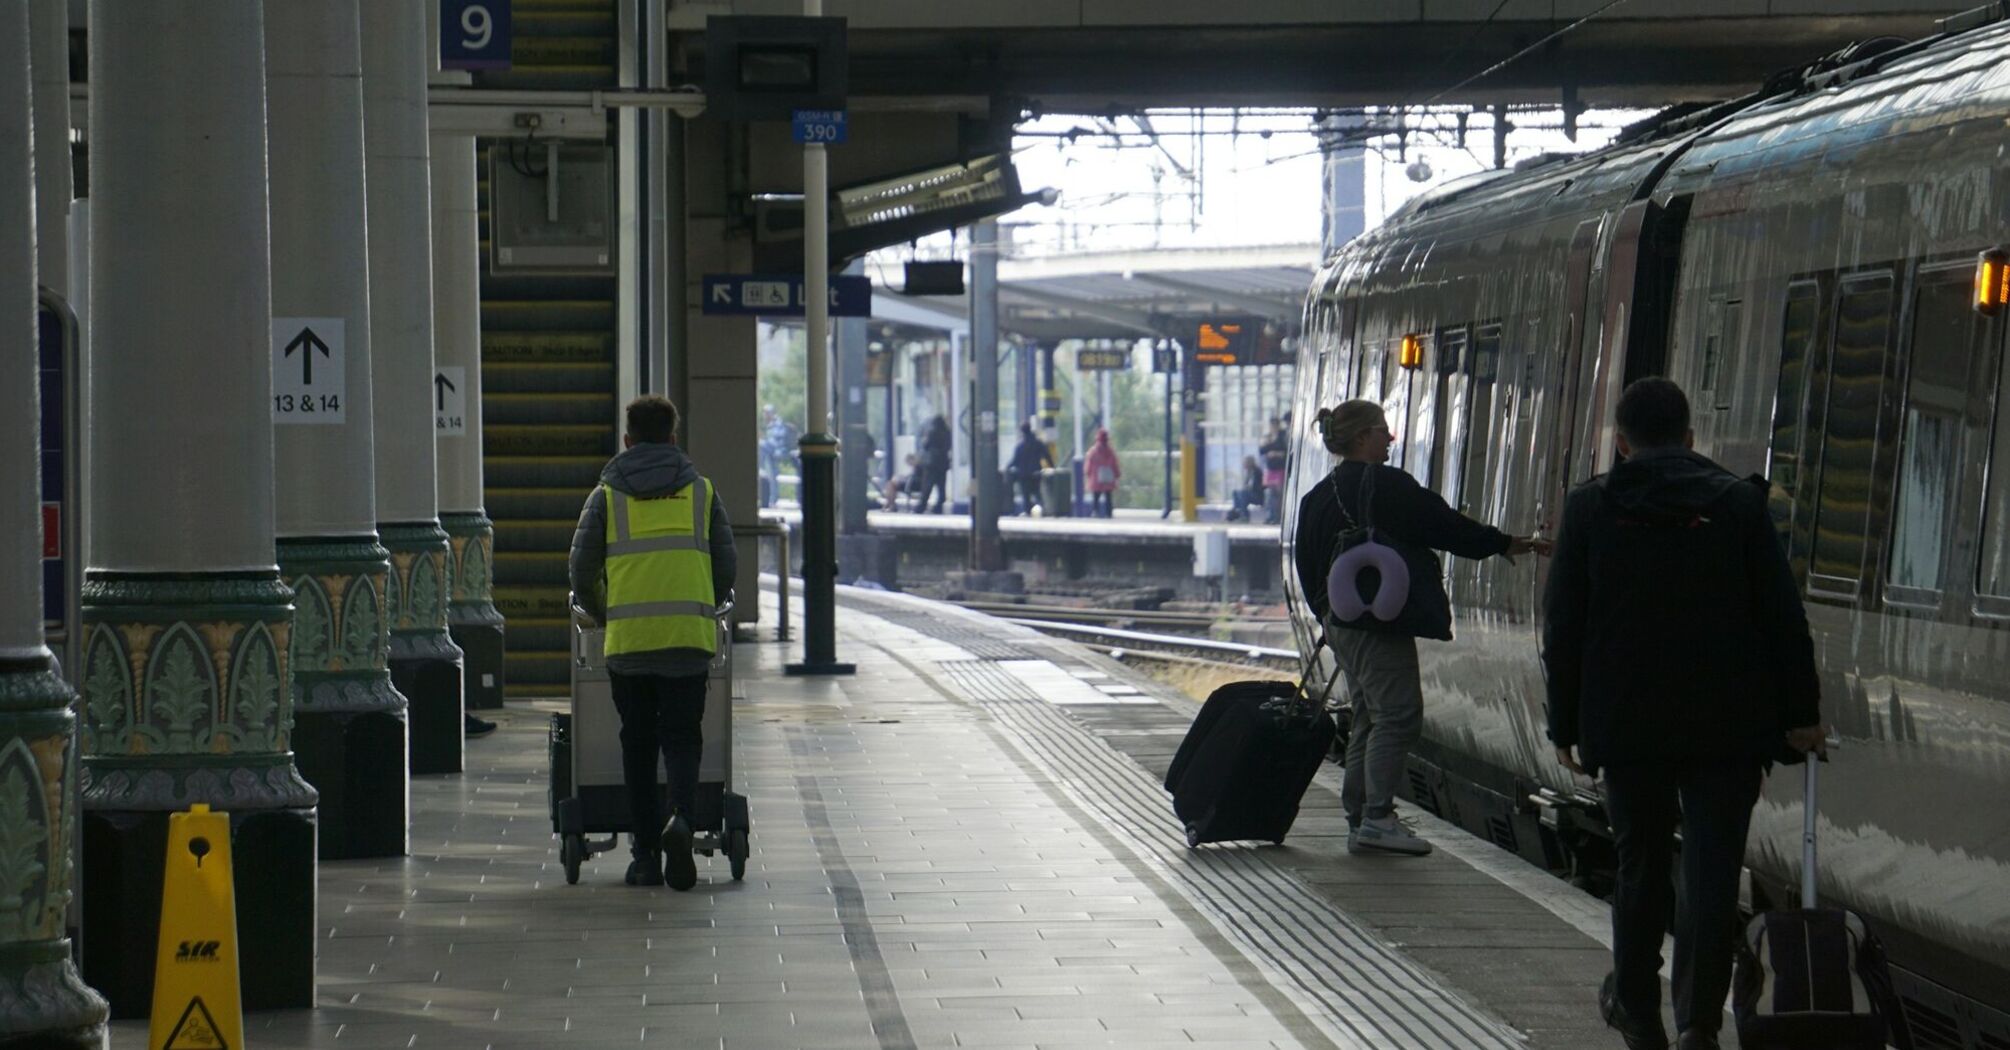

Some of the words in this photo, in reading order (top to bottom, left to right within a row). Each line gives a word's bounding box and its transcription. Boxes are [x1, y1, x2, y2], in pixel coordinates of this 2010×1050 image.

[461, 4, 493, 50] 9
[804, 124, 837, 141] 390
[797, 283, 839, 306] Lt
[274, 395, 294, 412] 13
[300, 395, 315, 412] &
[319, 395, 340, 412] 14
[436, 416, 446, 429] &
[449, 416, 462, 429] 14
[176, 940, 221, 956] SIR
